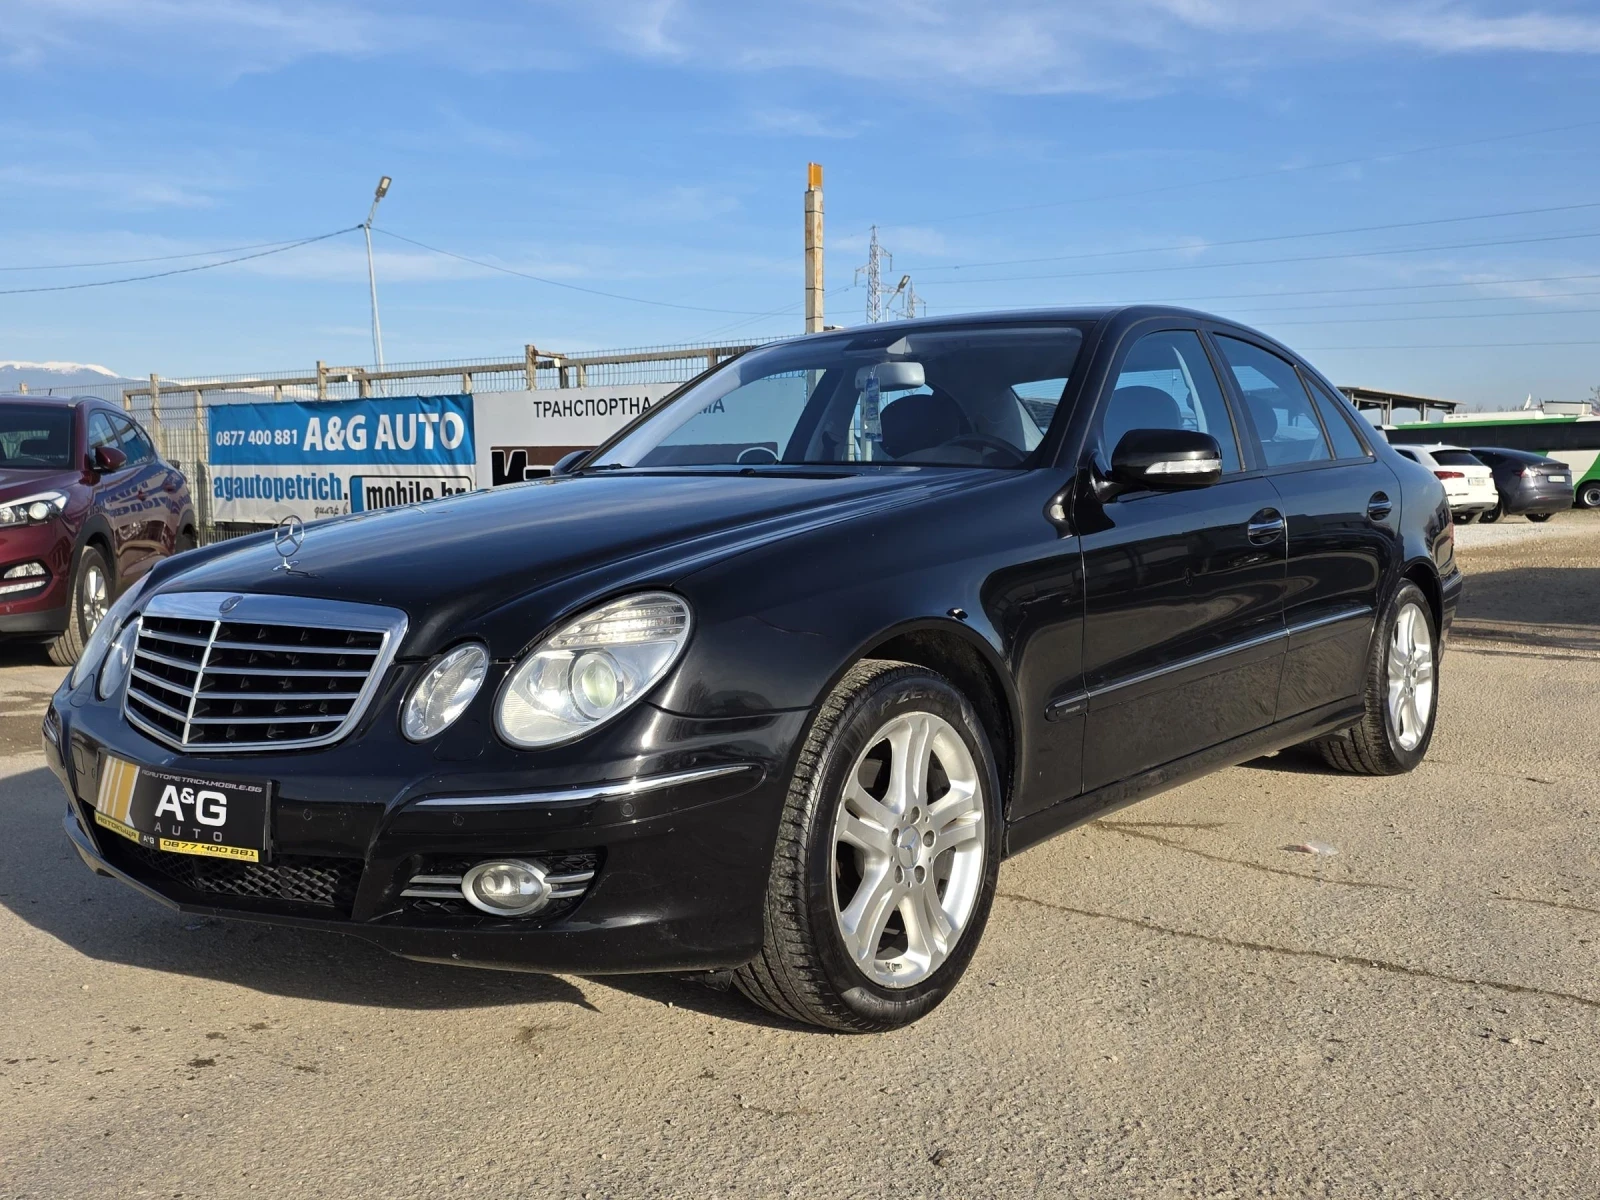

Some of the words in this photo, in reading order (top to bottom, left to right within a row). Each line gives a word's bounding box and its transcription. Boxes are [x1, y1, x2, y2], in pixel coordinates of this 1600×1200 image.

[533, 396, 653, 418] ТРАНСПОРТНА
[216, 431, 245, 446] 0877
[248, 430, 272, 445] 400
[274, 429, 298, 445] 881
[303, 414, 368, 451] A&G
[374, 411, 465, 450] AUTO
[154, 784, 227, 827] A&G
[154, 822, 223, 842] AUTO
[163, 840, 198, 850] 0877
[201, 845, 228, 853] 400
[230, 848, 256, 857] 881
